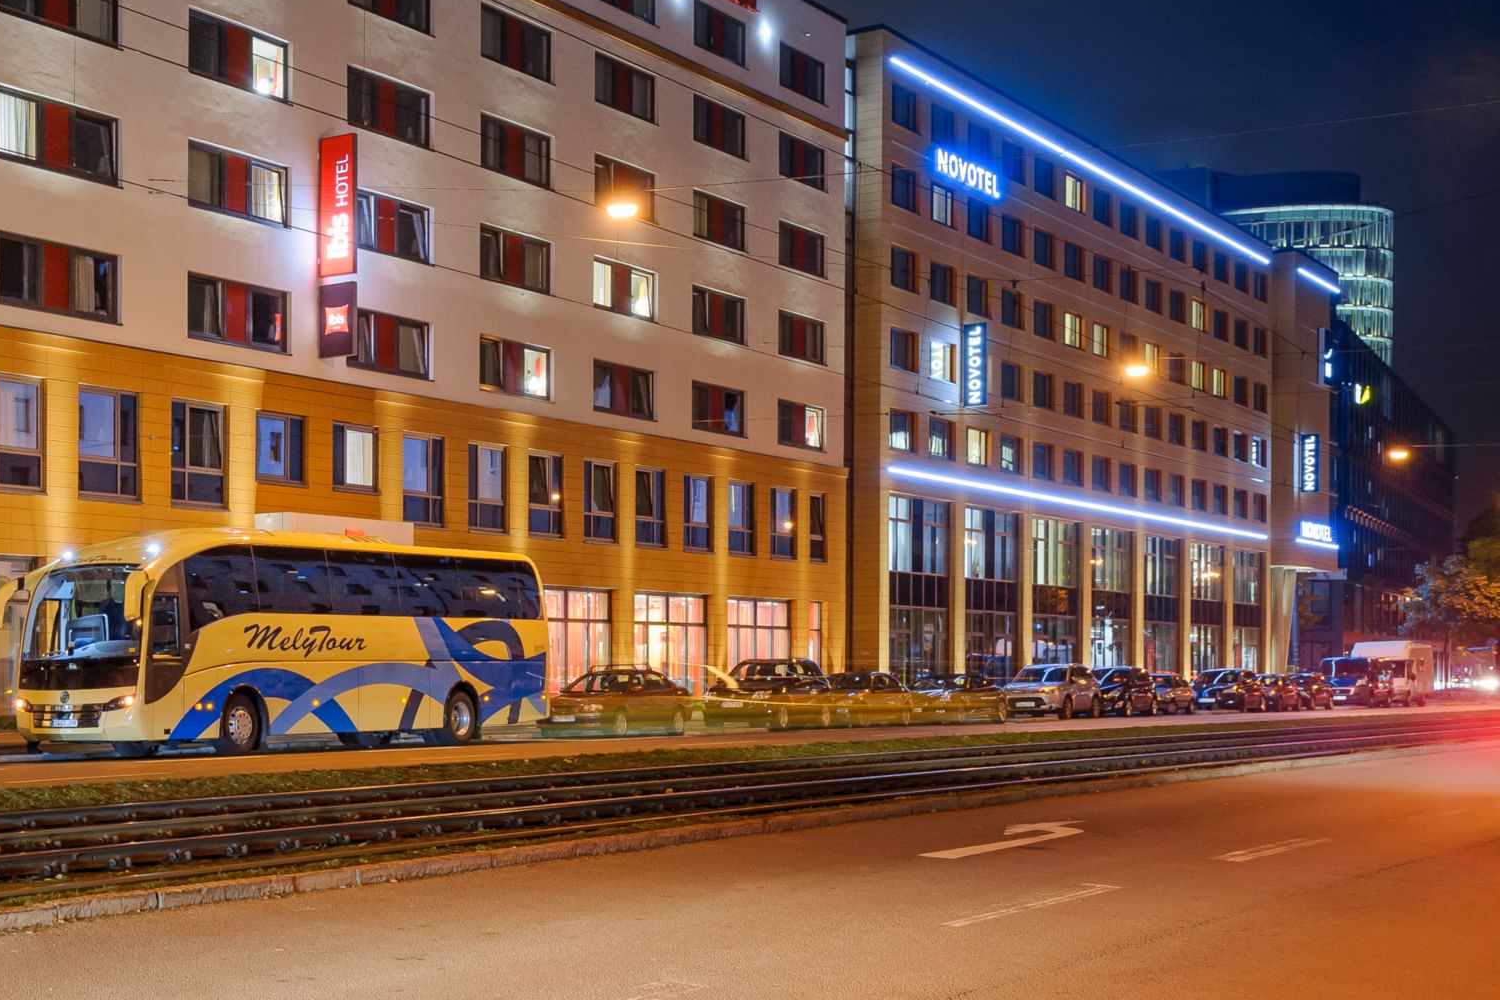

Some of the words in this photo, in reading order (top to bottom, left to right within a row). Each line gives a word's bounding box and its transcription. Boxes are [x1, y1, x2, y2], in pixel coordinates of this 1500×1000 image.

[335, 153, 350, 207] HOTEL
[936, 148, 1000, 199] NOVOTEL
[327, 212, 349, 260] ibis
[328, 313, 345, 325] ibis
[968, 325, 982, 405] NOVOTEL
[1303, 435, 1316, 491] NOVOTEL
[243, 623, 368, 659] MelyTour
